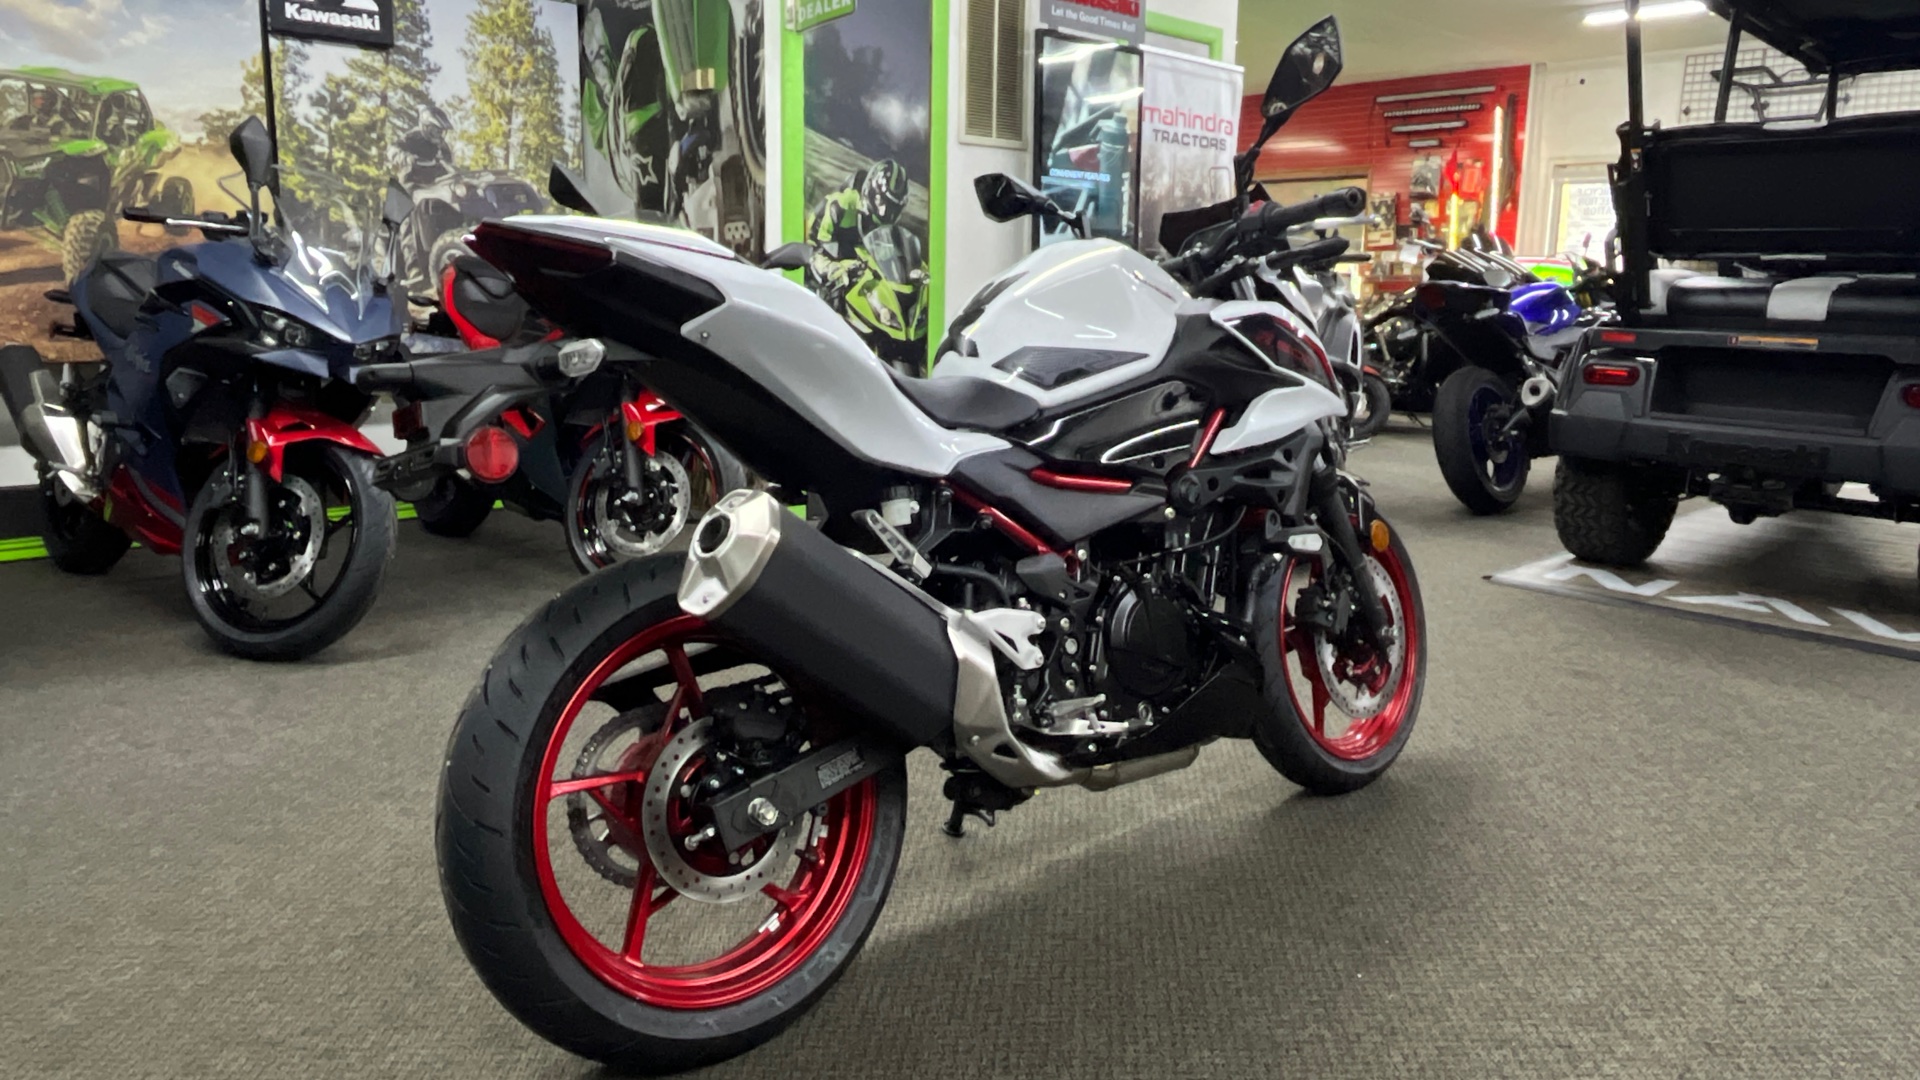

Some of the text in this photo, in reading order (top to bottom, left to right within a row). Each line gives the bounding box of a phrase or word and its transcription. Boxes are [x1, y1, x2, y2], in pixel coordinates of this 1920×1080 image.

[284, 2, 380, 31] Kawasaki
[798, 0, 851, 23] DEALER
[1051, 4, 1064, 17] Let
[1066, 9, 1078, 20] the
[1079, 11, 1099, 25] Good
[1100, 16, 1120, 30] Times
[1141, 106, 1234, 136] mahindra
[1152, 129, 1227, 151] TRACTORS
